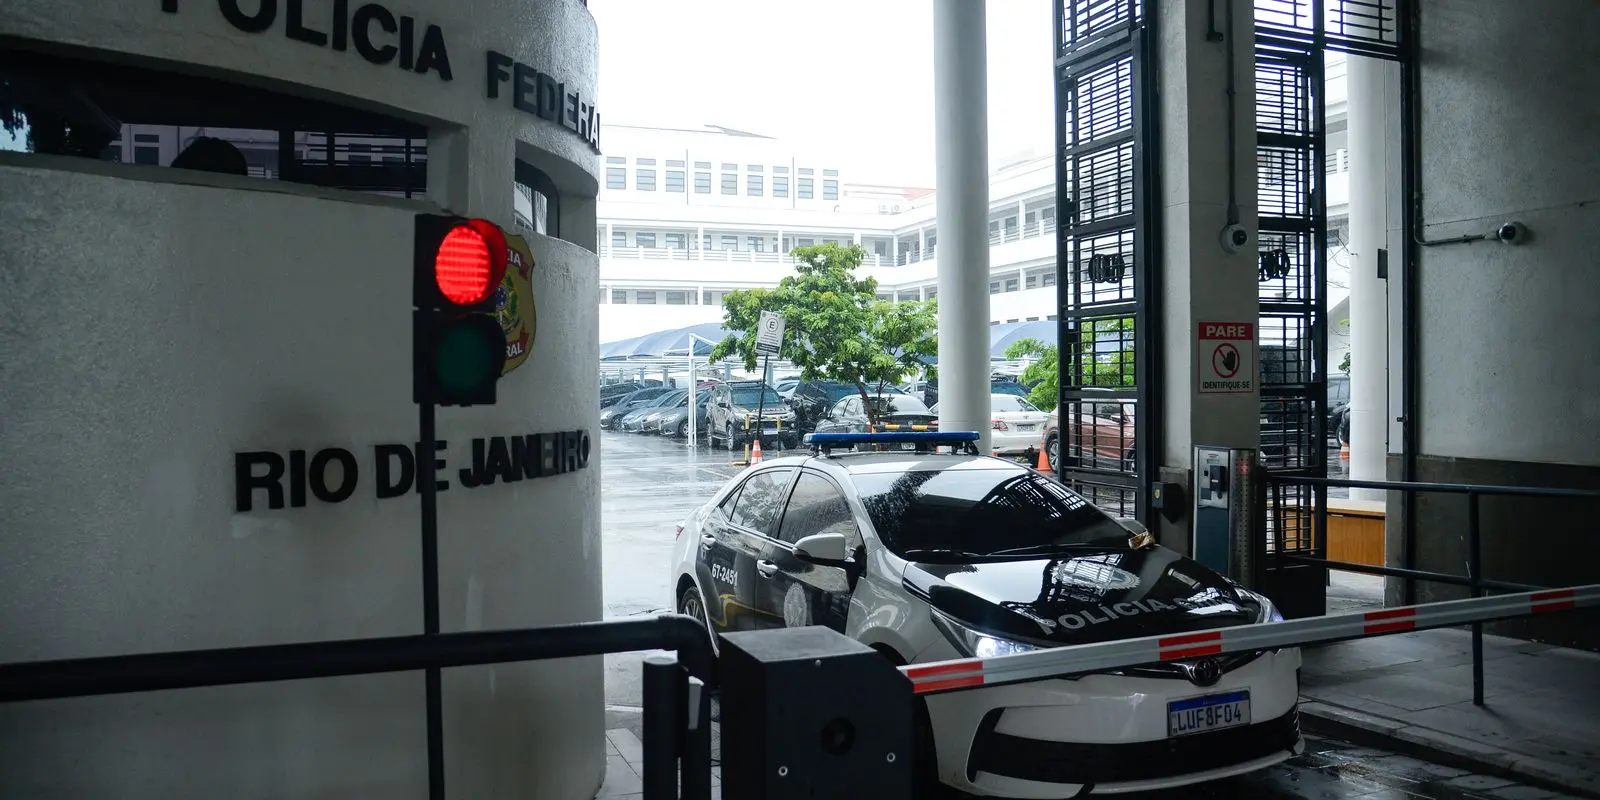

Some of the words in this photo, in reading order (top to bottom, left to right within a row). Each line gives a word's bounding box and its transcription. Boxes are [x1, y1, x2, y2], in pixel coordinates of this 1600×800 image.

[487, 50, 601, 155] FEDERA
[1206, 325, 1246, 337] PARE
[1202, 381, 1251, 390] IDENTIFIQUE-SE
[235, 447, 359, 511] RIO
[375, 440, 450, 499] DE
[459, 429, 592, 488] JANEIRO
[711, 563, 738, 586] 67-2451
[1177, 703, 1242, 731] LUF8F04
